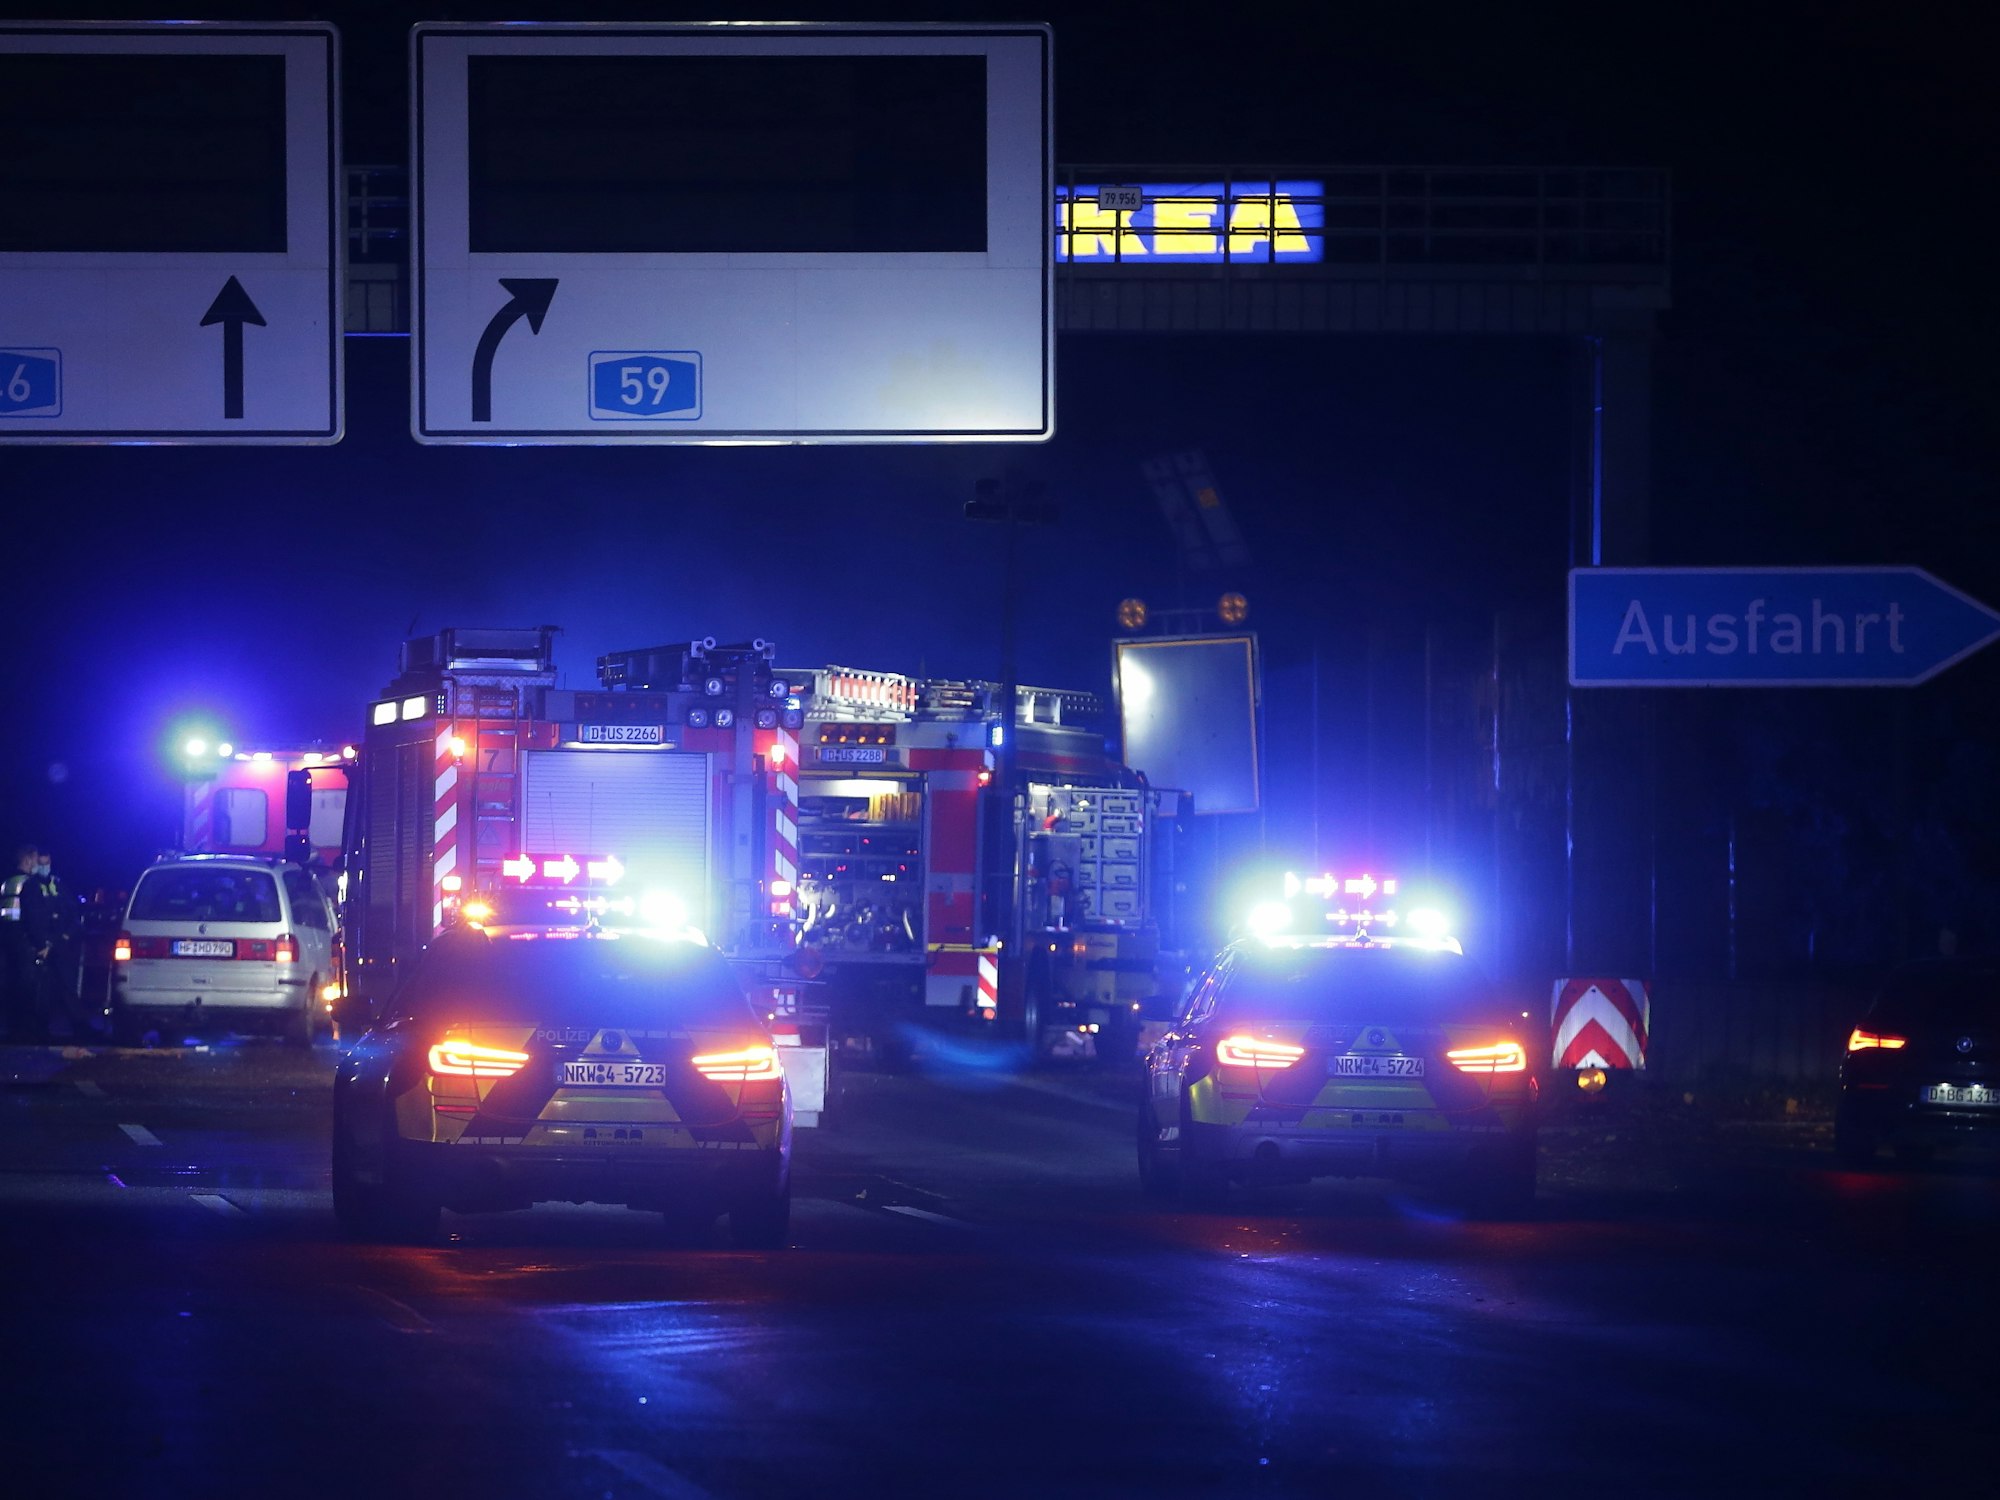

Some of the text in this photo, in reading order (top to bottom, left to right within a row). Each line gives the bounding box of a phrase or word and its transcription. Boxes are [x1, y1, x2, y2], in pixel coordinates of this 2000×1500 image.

[1105, 193, 1136, 205] 79.956
[0, 363, 31, 402] 6
[621, 366, 670, 406] 59
[1613, 599, 1905, 655] Ausfahrt
[626, 727, 657, 740] 2266
[484, 749, 500, 771] 7
[536, 1030, 590, 1042] POLIZEI
[565, 1065, 596, 1082] NRW
[1335, 1058, 1363, 1074] NRW
